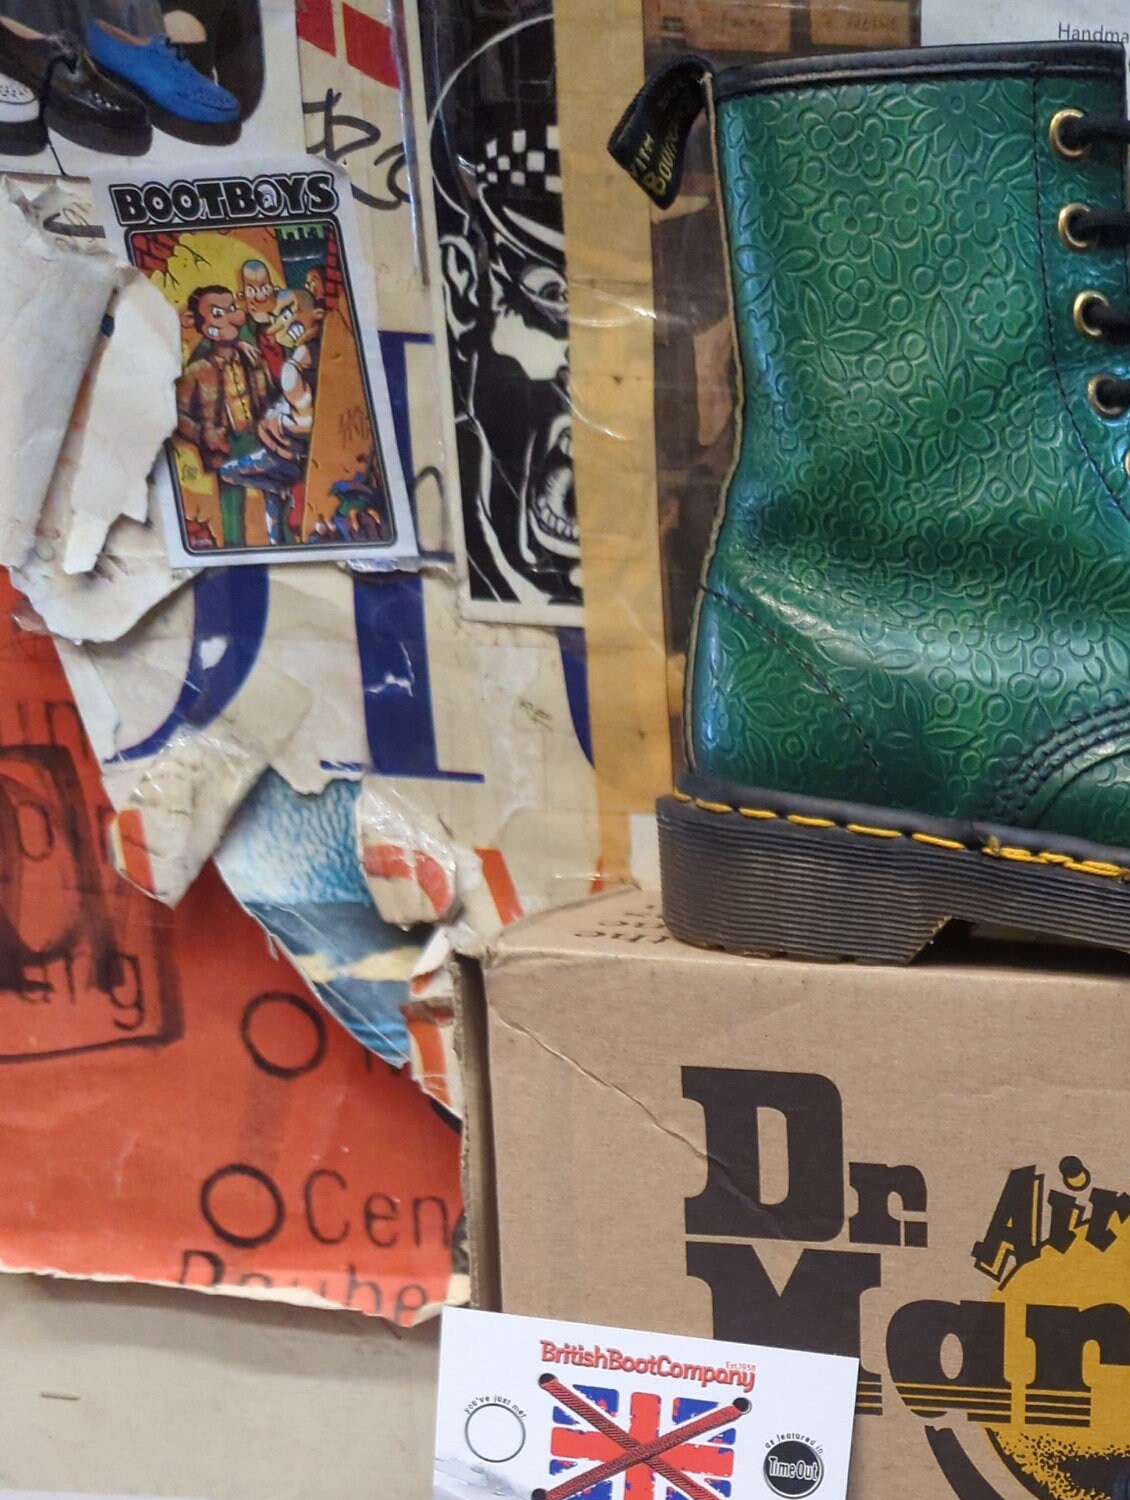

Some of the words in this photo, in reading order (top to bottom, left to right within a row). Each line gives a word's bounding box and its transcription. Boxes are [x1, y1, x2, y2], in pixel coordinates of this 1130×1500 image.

[109, 171, 338, 227] BOOTBOYS
[680, 1065, 929, 1249] Dr.
[539, 1340, 756, 1393] BritishBootCompany
[768, 1456, 794, 1478] Time
[794, 1460, 819, 1481] Out
